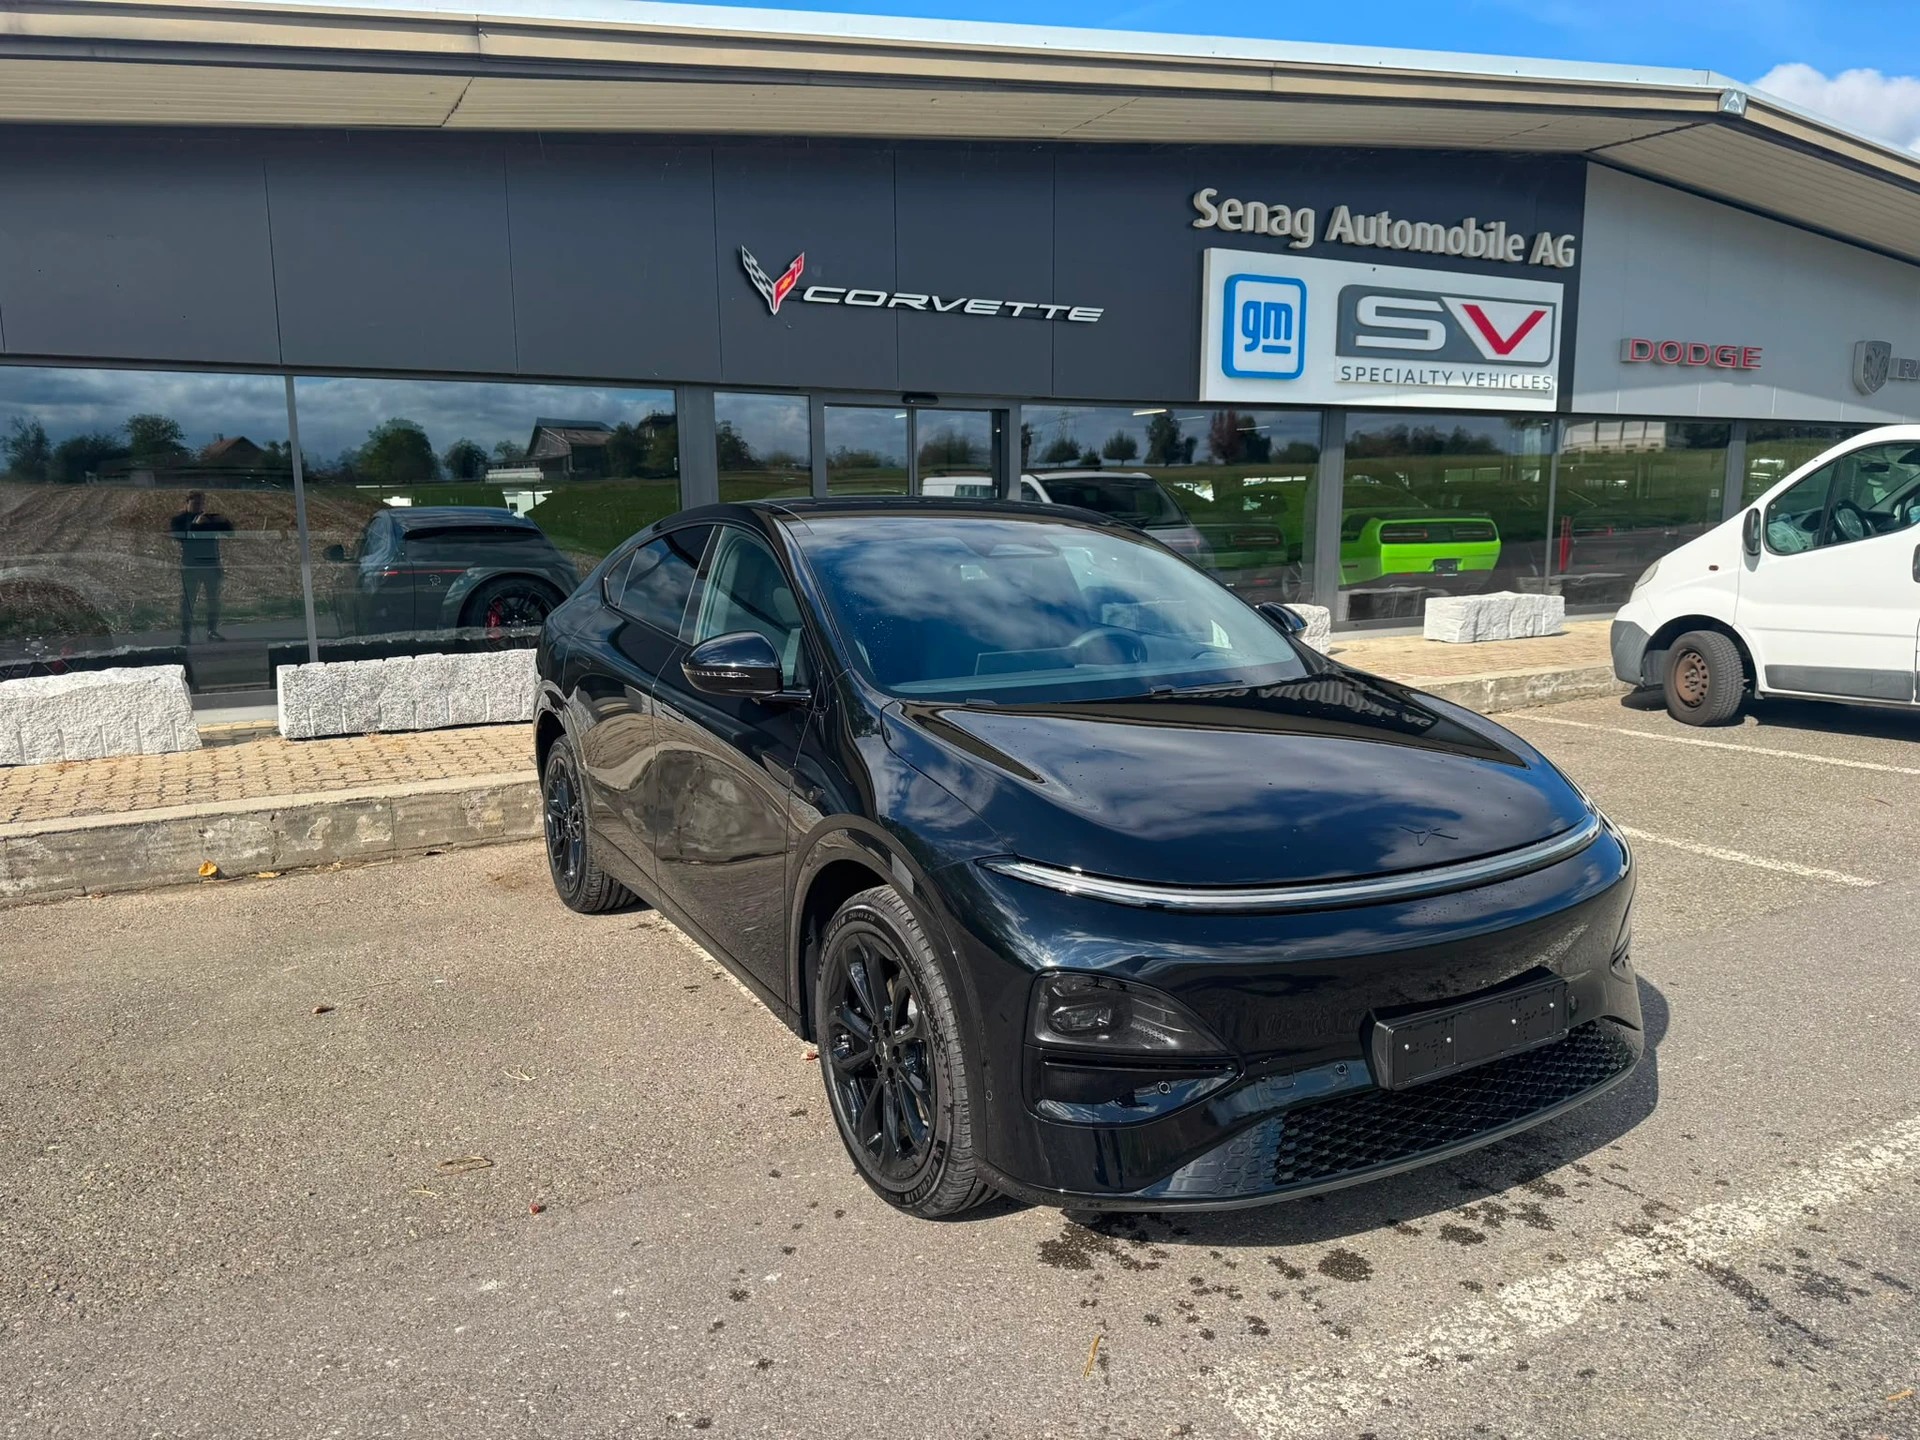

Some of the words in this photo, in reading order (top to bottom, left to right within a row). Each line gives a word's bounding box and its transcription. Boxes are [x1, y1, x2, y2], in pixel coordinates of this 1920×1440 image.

[1192, 187, 1315, 249] Senag
[1324, 205, 1525, 263] Automobile
[1528, 231, 1576, 268] AG
[803, 285, 1104, 322] CORVETTE
[1241, 300, 1293, 354] gm
[1355, 295, 1547, 355] SV
[1627, 338, 1764, 370] DODGE
[1895, 358, 1920, 380] R
[1341, 366, 1453, 386] SPECIALTY
[1462, 371, 1553, 390] VEHICLES
